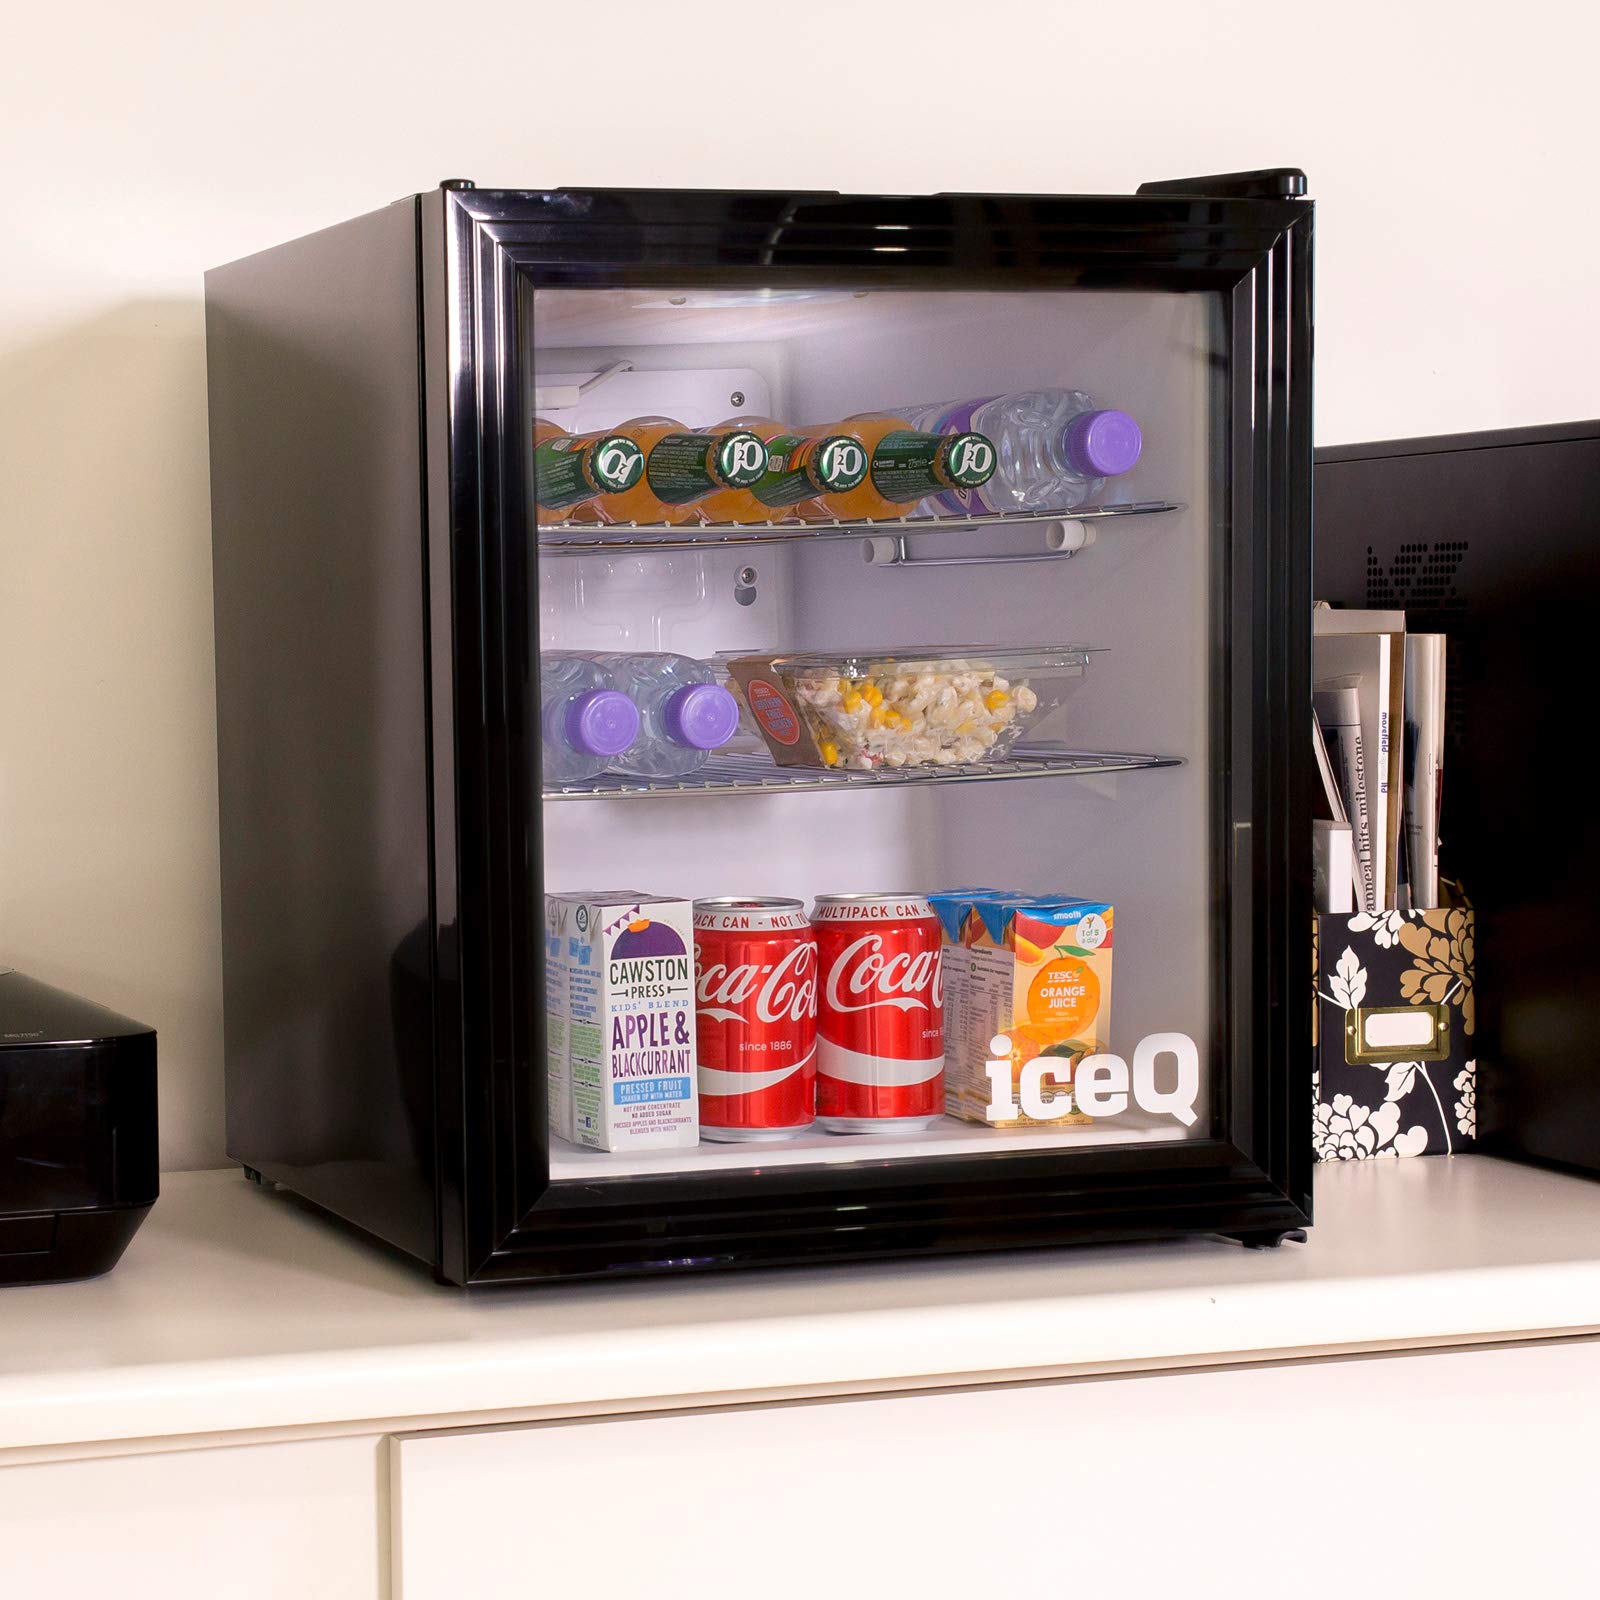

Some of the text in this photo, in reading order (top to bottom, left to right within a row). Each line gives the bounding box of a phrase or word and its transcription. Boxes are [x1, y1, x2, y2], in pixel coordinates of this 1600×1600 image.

[1355, 736, 1369, 816] milestone
[1359, 821, 1370, 852] hits
[817, 905, 889, 919] MULTIPACK
[895, 904, 920, 917] CAN
[1053, 911, 1081, 920] smooth
[722, 915, 750, 929] CAN
[770, 914, 793, 928] NOT
[610, 958, 688, 985] CAWSTON
[631, 984, 665, 999] PRESS
[1040, 985, 1086, 998] ORANGE
[648, 1000, 689, 1009] BLEND
[1048, 997, 1077, 1009] JUICE
[612, 1012, 670, 1051] APPLE
[674, 1010, 690, 1045] &
[739, 1041, 792, 1052] since 1886
[612, 1049, 691, 1078] BLACKCURRANT
[985, 1032, 1199, 1127] iceQ
[620, 1080, 683, 1095] PRESSED FRUIT
